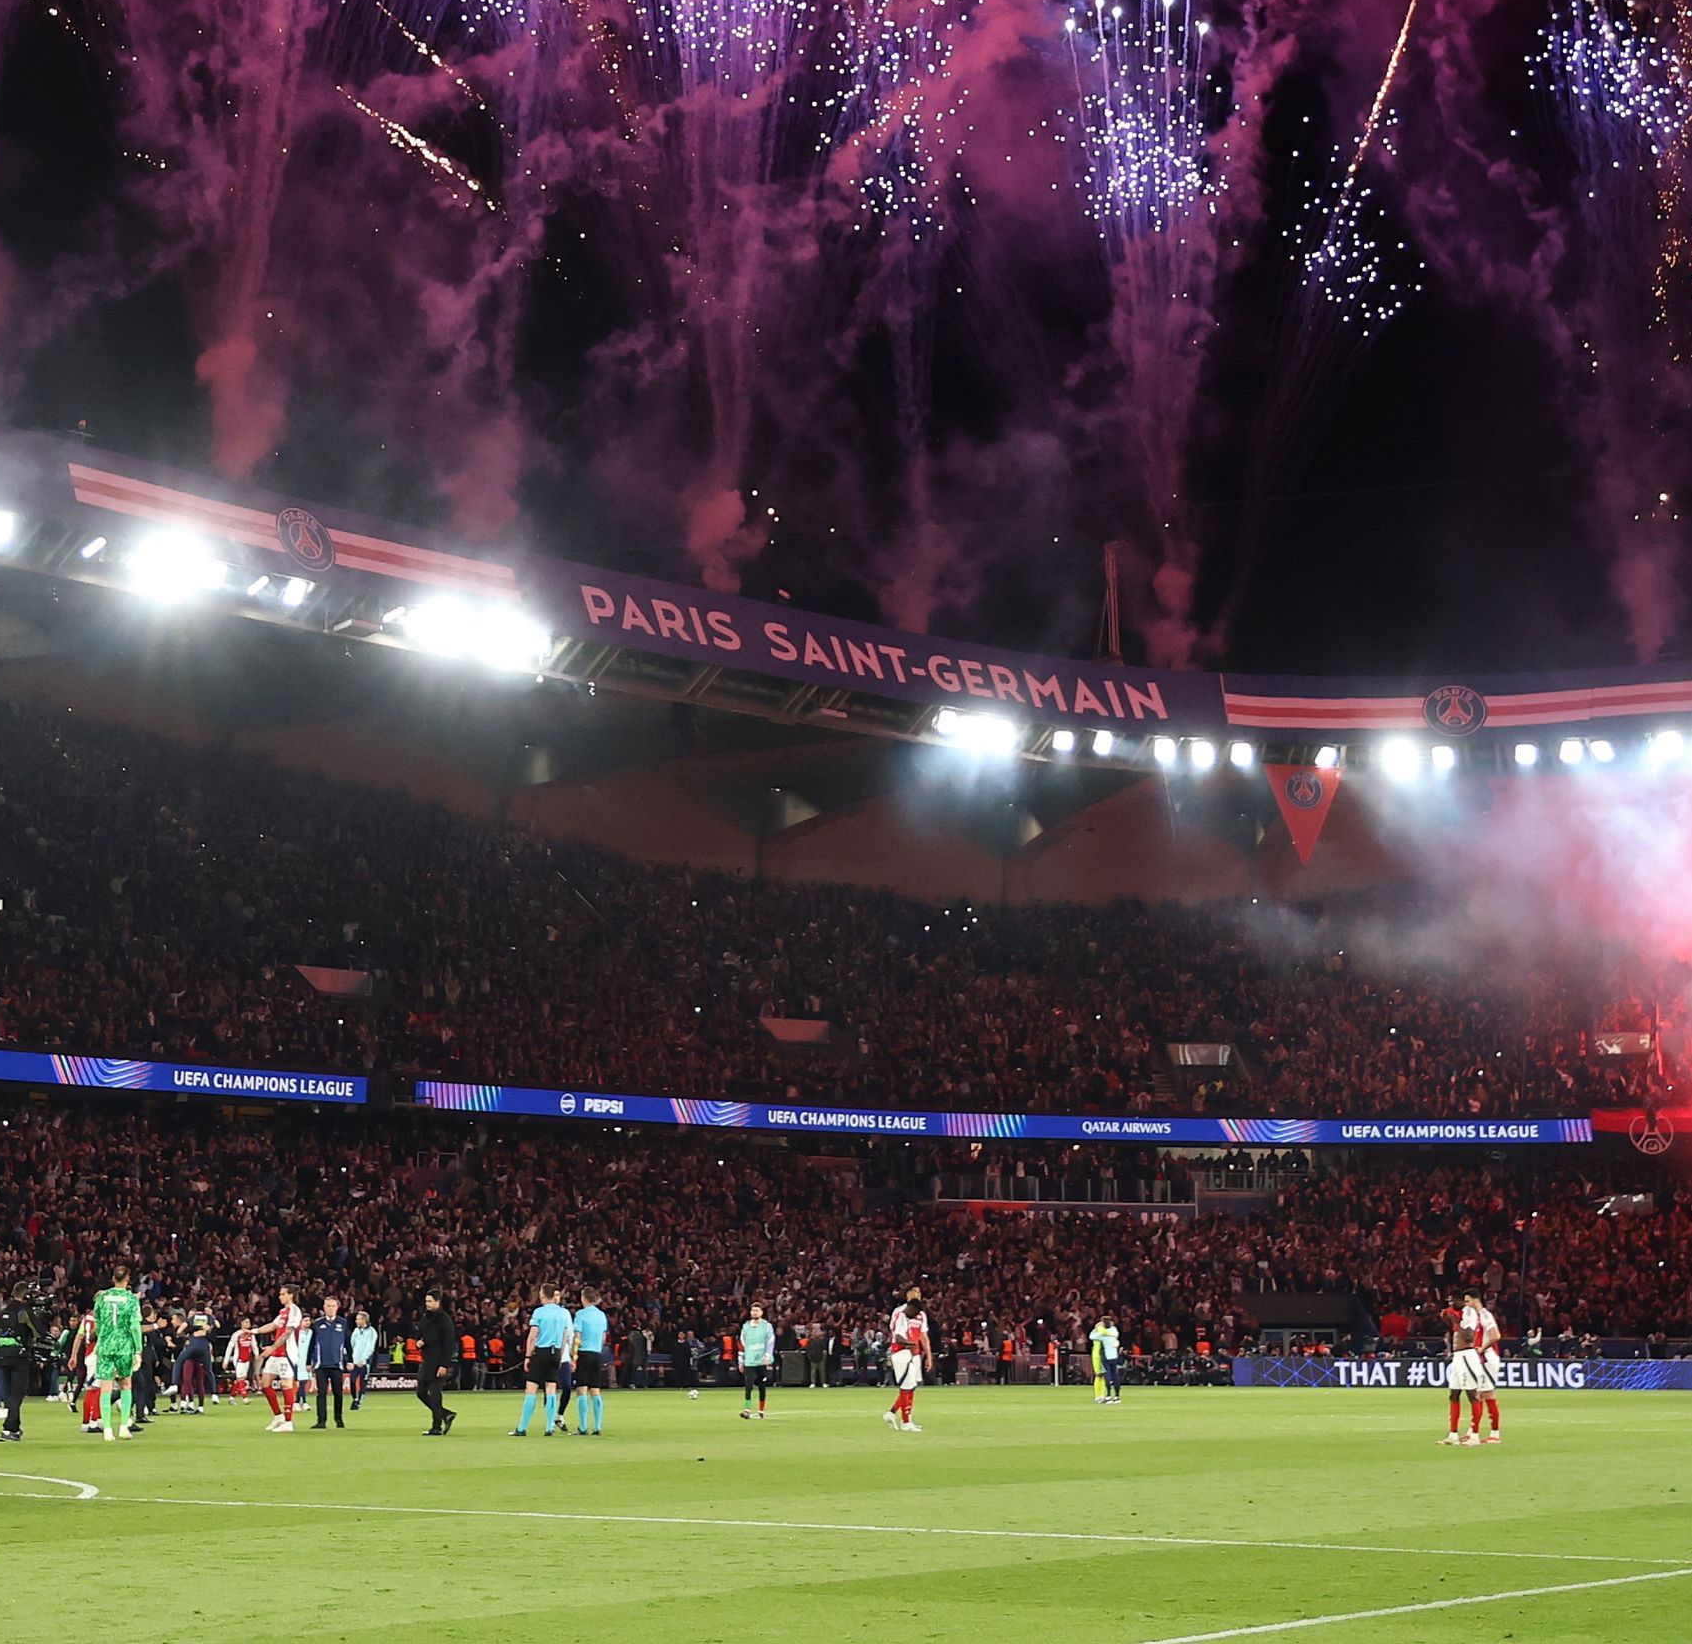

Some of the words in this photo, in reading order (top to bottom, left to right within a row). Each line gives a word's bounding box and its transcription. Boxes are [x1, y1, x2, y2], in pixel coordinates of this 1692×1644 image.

[580, 584, 742, 651] PARIS
[764, 621, 1169, 720] SAINT-GERMAIN
[173, 1069, 210, 1088] UEFA
[213, 1072, 298, 1094] CHAMPIONS
[301, 1078, 354, 1097] LEAGUE
[584, 1098, 624, 1114] PEPSI
[767, 1110, 797, 1125] UEFA
[800, 1112, 876, 1130] CHAMPIONS
[878, 1115, 927, 1131] LEAGUE
[1082, 1120, 1120, 1135] QATAR
[1121, 1121, 1171, 1135] AIRWAYS
[1341, 1125, 1381, 1139] UEFA
[1383, 1125, 1476, 1140] CHAMPIONS
[1479, 1125, 1539, 1140] LEAGUE
[1334, 1361, 1400, 1386] THAT
[1407, 1360, 1585, 1389] #UEELING
